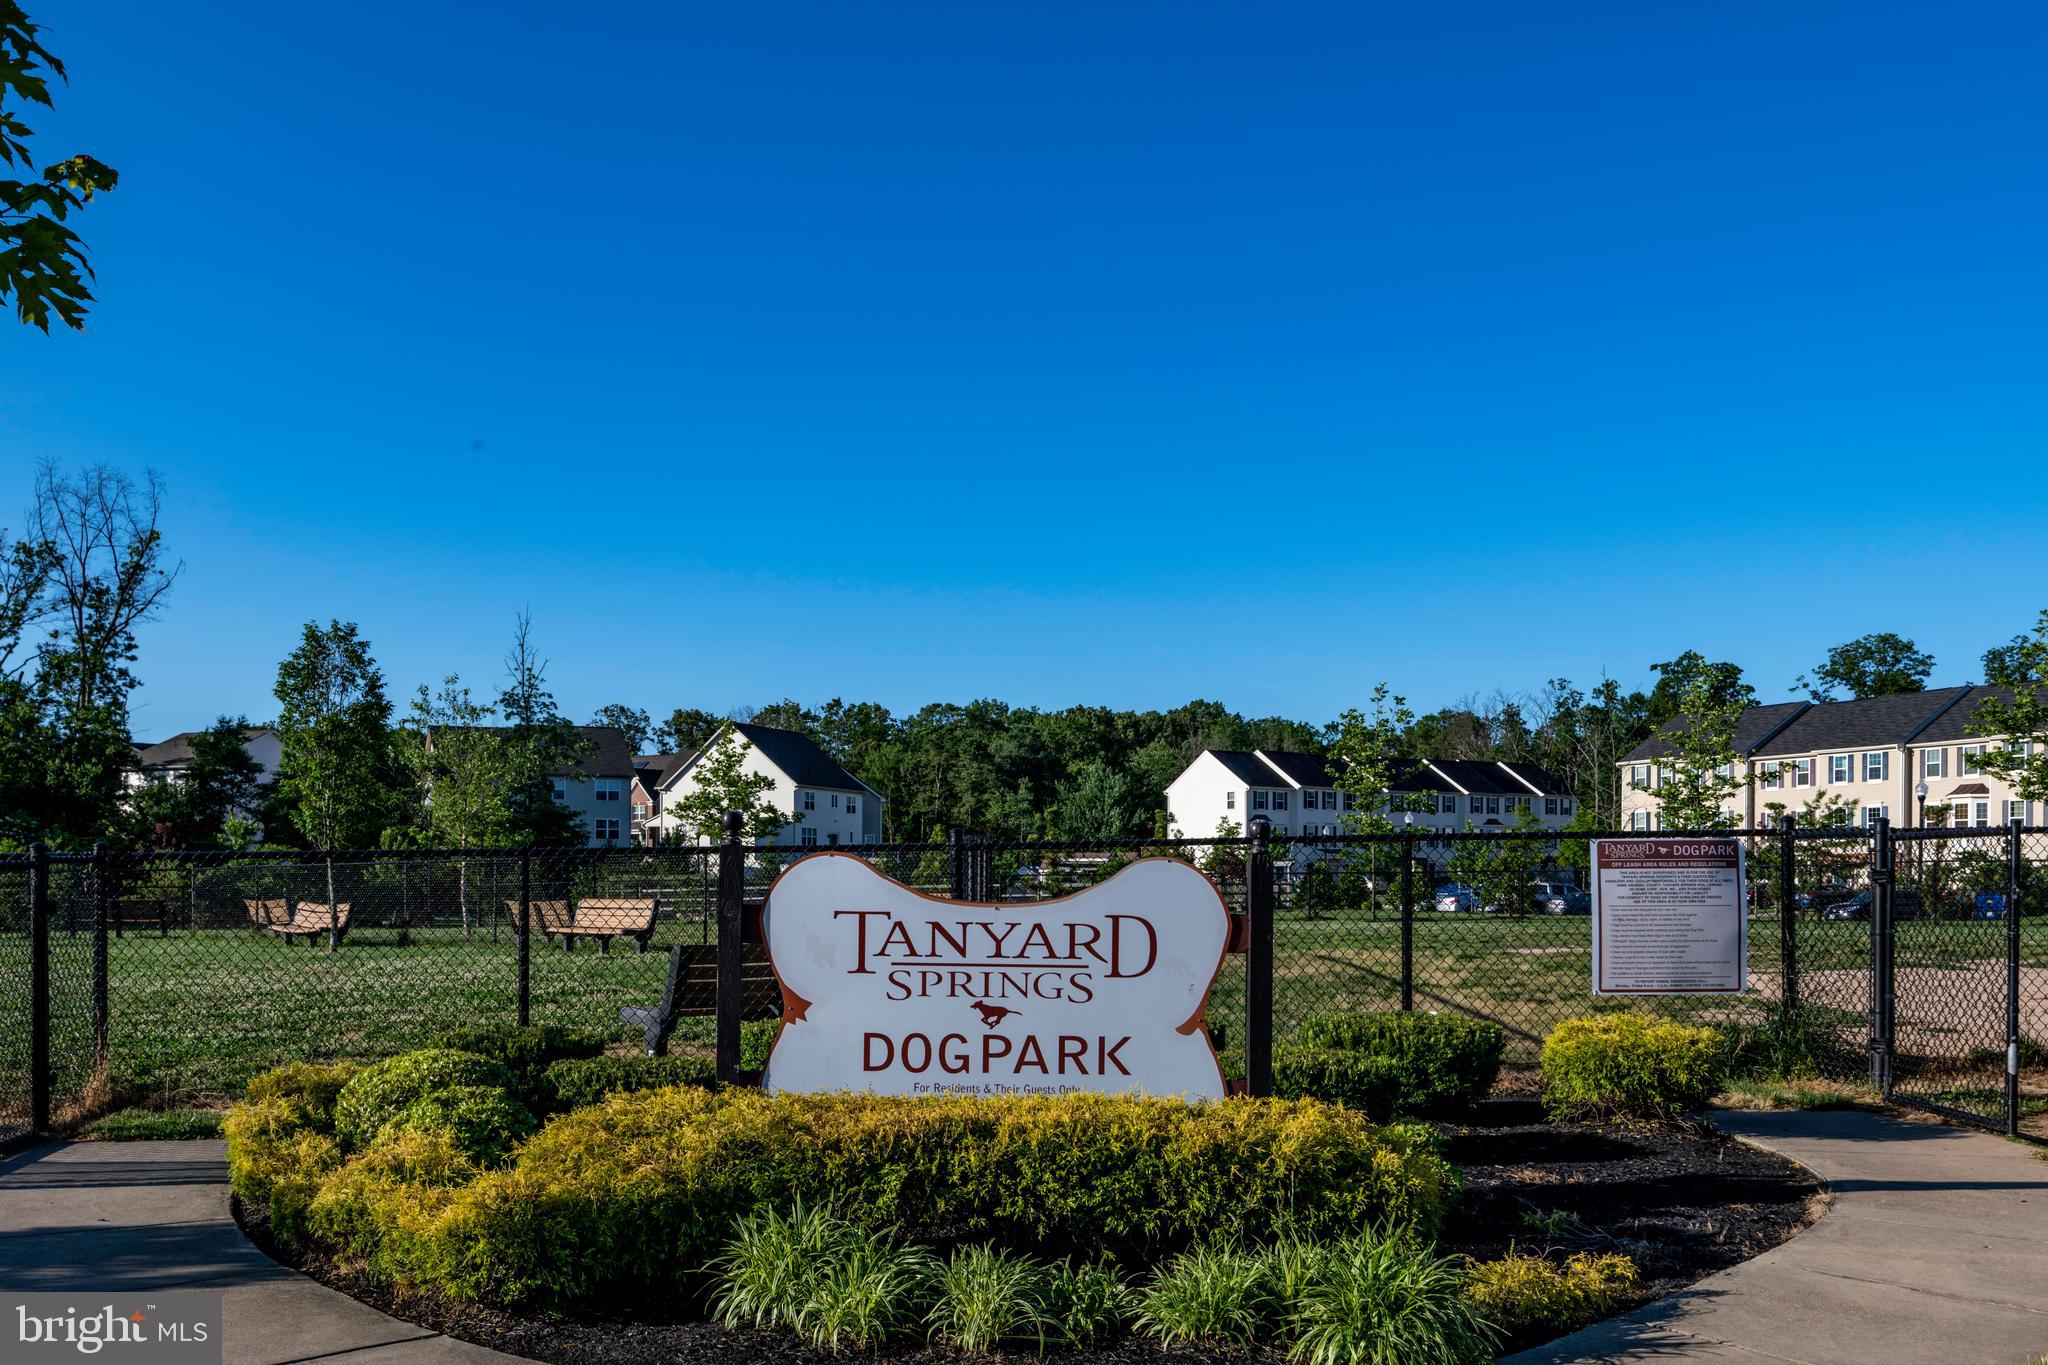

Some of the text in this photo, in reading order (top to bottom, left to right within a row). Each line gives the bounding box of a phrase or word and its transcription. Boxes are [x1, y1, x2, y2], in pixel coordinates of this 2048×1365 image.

[1601, 842, 1655, 855] TANYARD
[1673, 845, 1735, 856] DOGPARK
[833, 910, 1158, 979] TANYARD
[886, 969, 1094, 1004] SPRINGS
[863, 1031, 1132, 1076] DOGPARK
[914, 1082, 930, 1093] For
[934, 1082, 981, 1094] Residents
[983, 1084, 992, 1094] &
[994, 1083, 1021, 1094] Their
[1023, 1084, 1056, 1095] Guests
